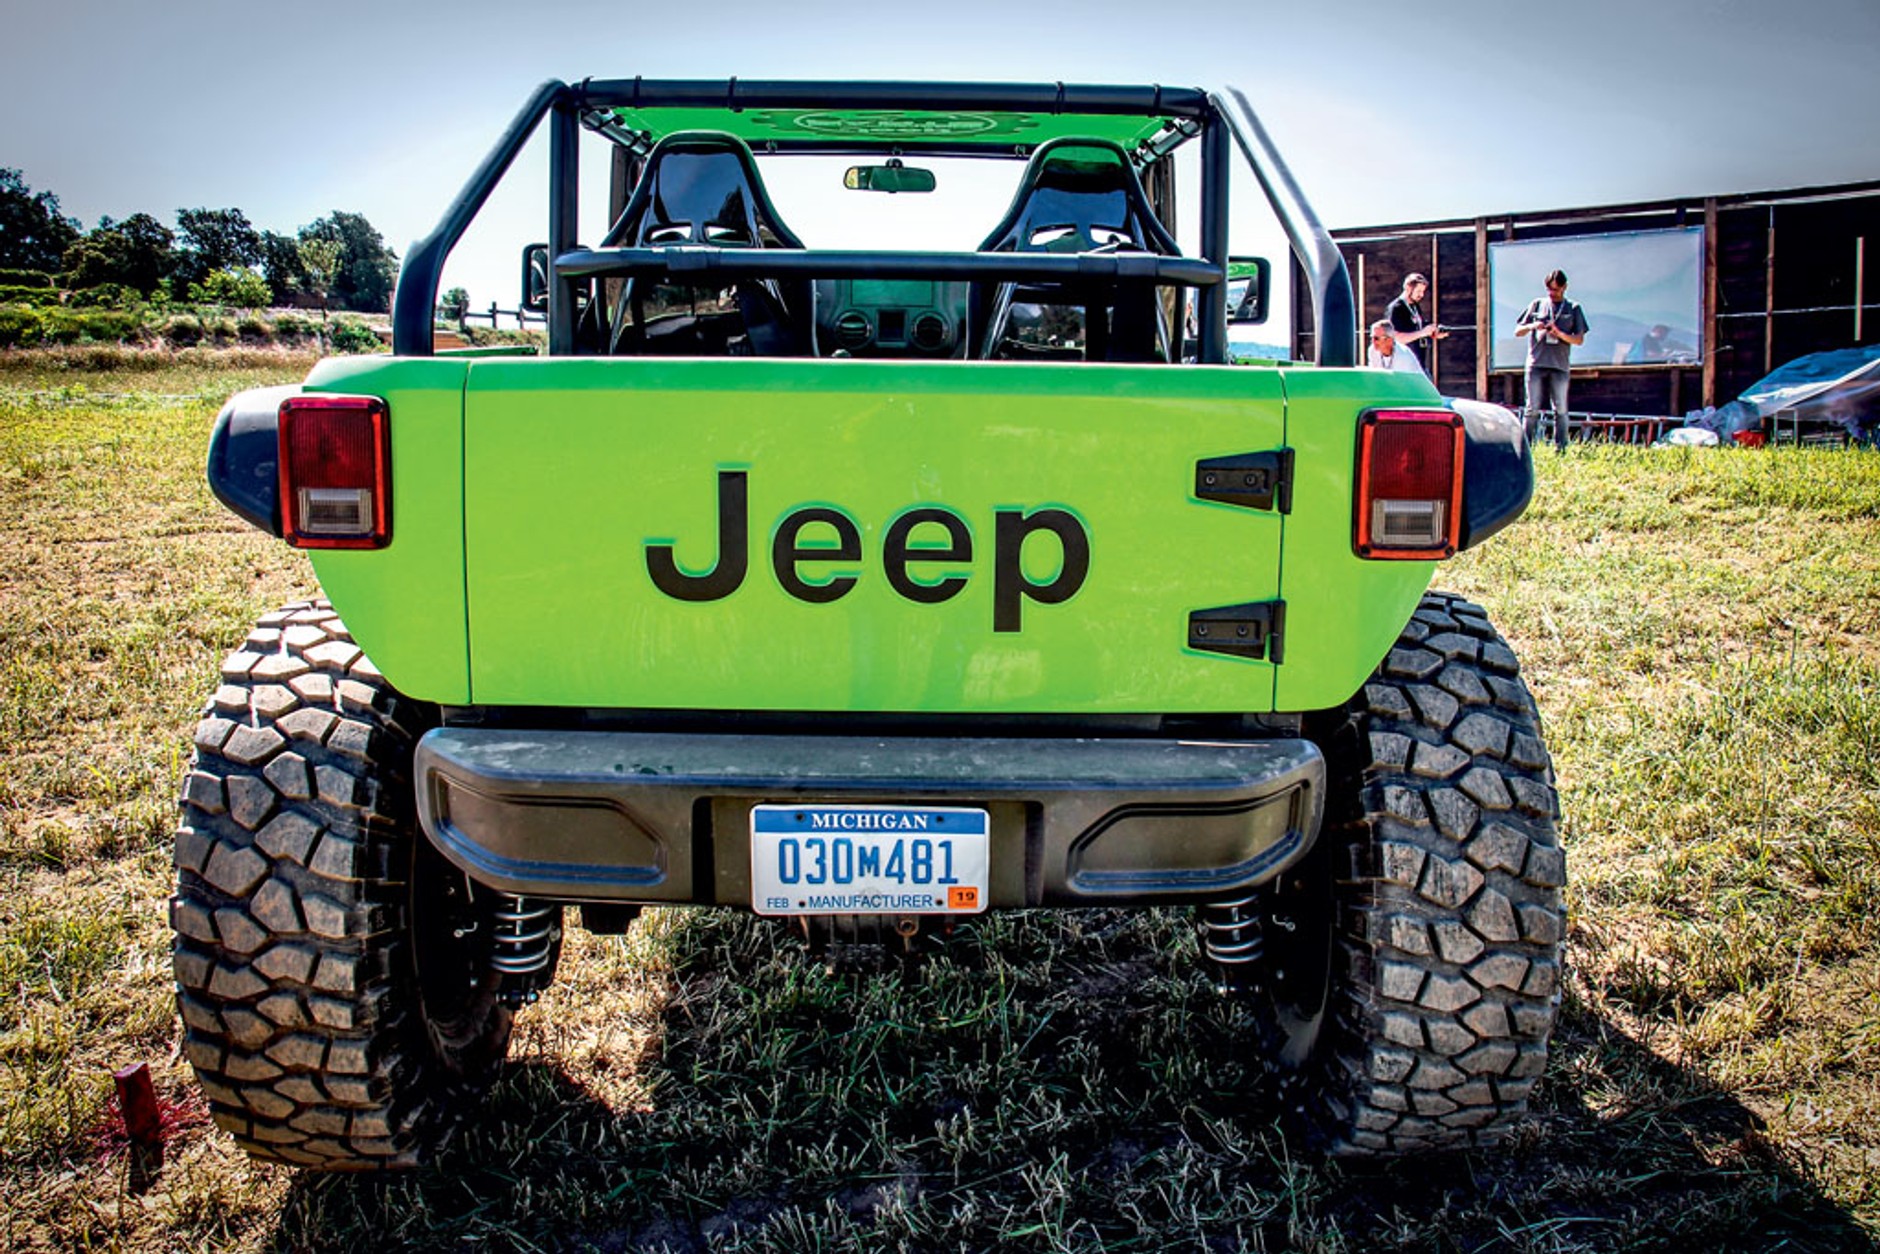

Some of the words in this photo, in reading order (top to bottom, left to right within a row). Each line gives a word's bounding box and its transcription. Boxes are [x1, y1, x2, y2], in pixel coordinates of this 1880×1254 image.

[645, 469, 1091, 633] Jeep
[812, 813, 928, 829] MICHIGAN
[767, 897, 789, 908] FEB
[809, 895, 933, 908] MANUFACTURER
[956, 891, 975, 901] 19
